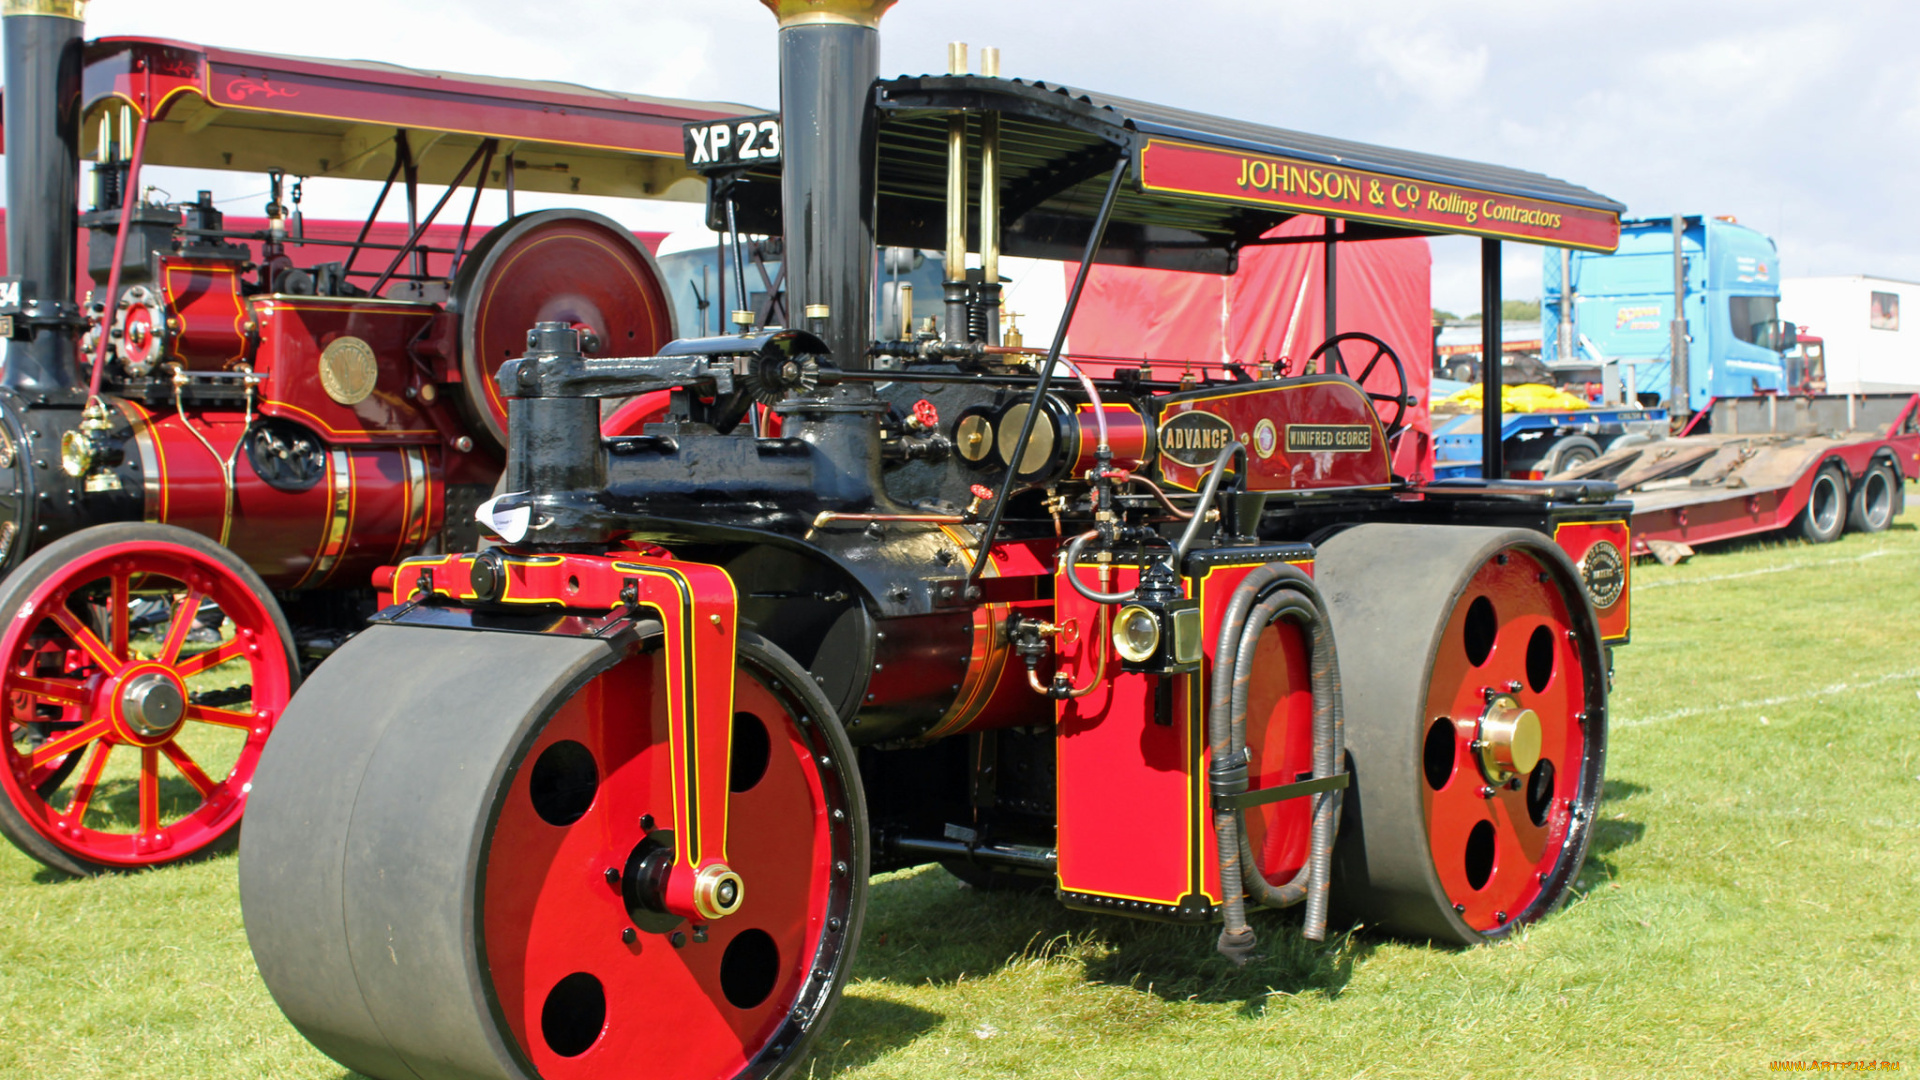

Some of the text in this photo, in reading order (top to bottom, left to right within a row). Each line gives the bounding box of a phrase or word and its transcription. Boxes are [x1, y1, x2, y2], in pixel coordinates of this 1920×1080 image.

[690, 120, 780, 164] XP 23
[1236, 158, 1362, 203] JOHNSON
[1368, 179, 1386, 206] &
[1427, 190, 1479, 223] Rolling
[1482, 199, 1563, 229] Contractors
[1165, 427, 1229, 450] ADVANCE
[1289, 430, 1370, 446] WINIFRED GEORGE
